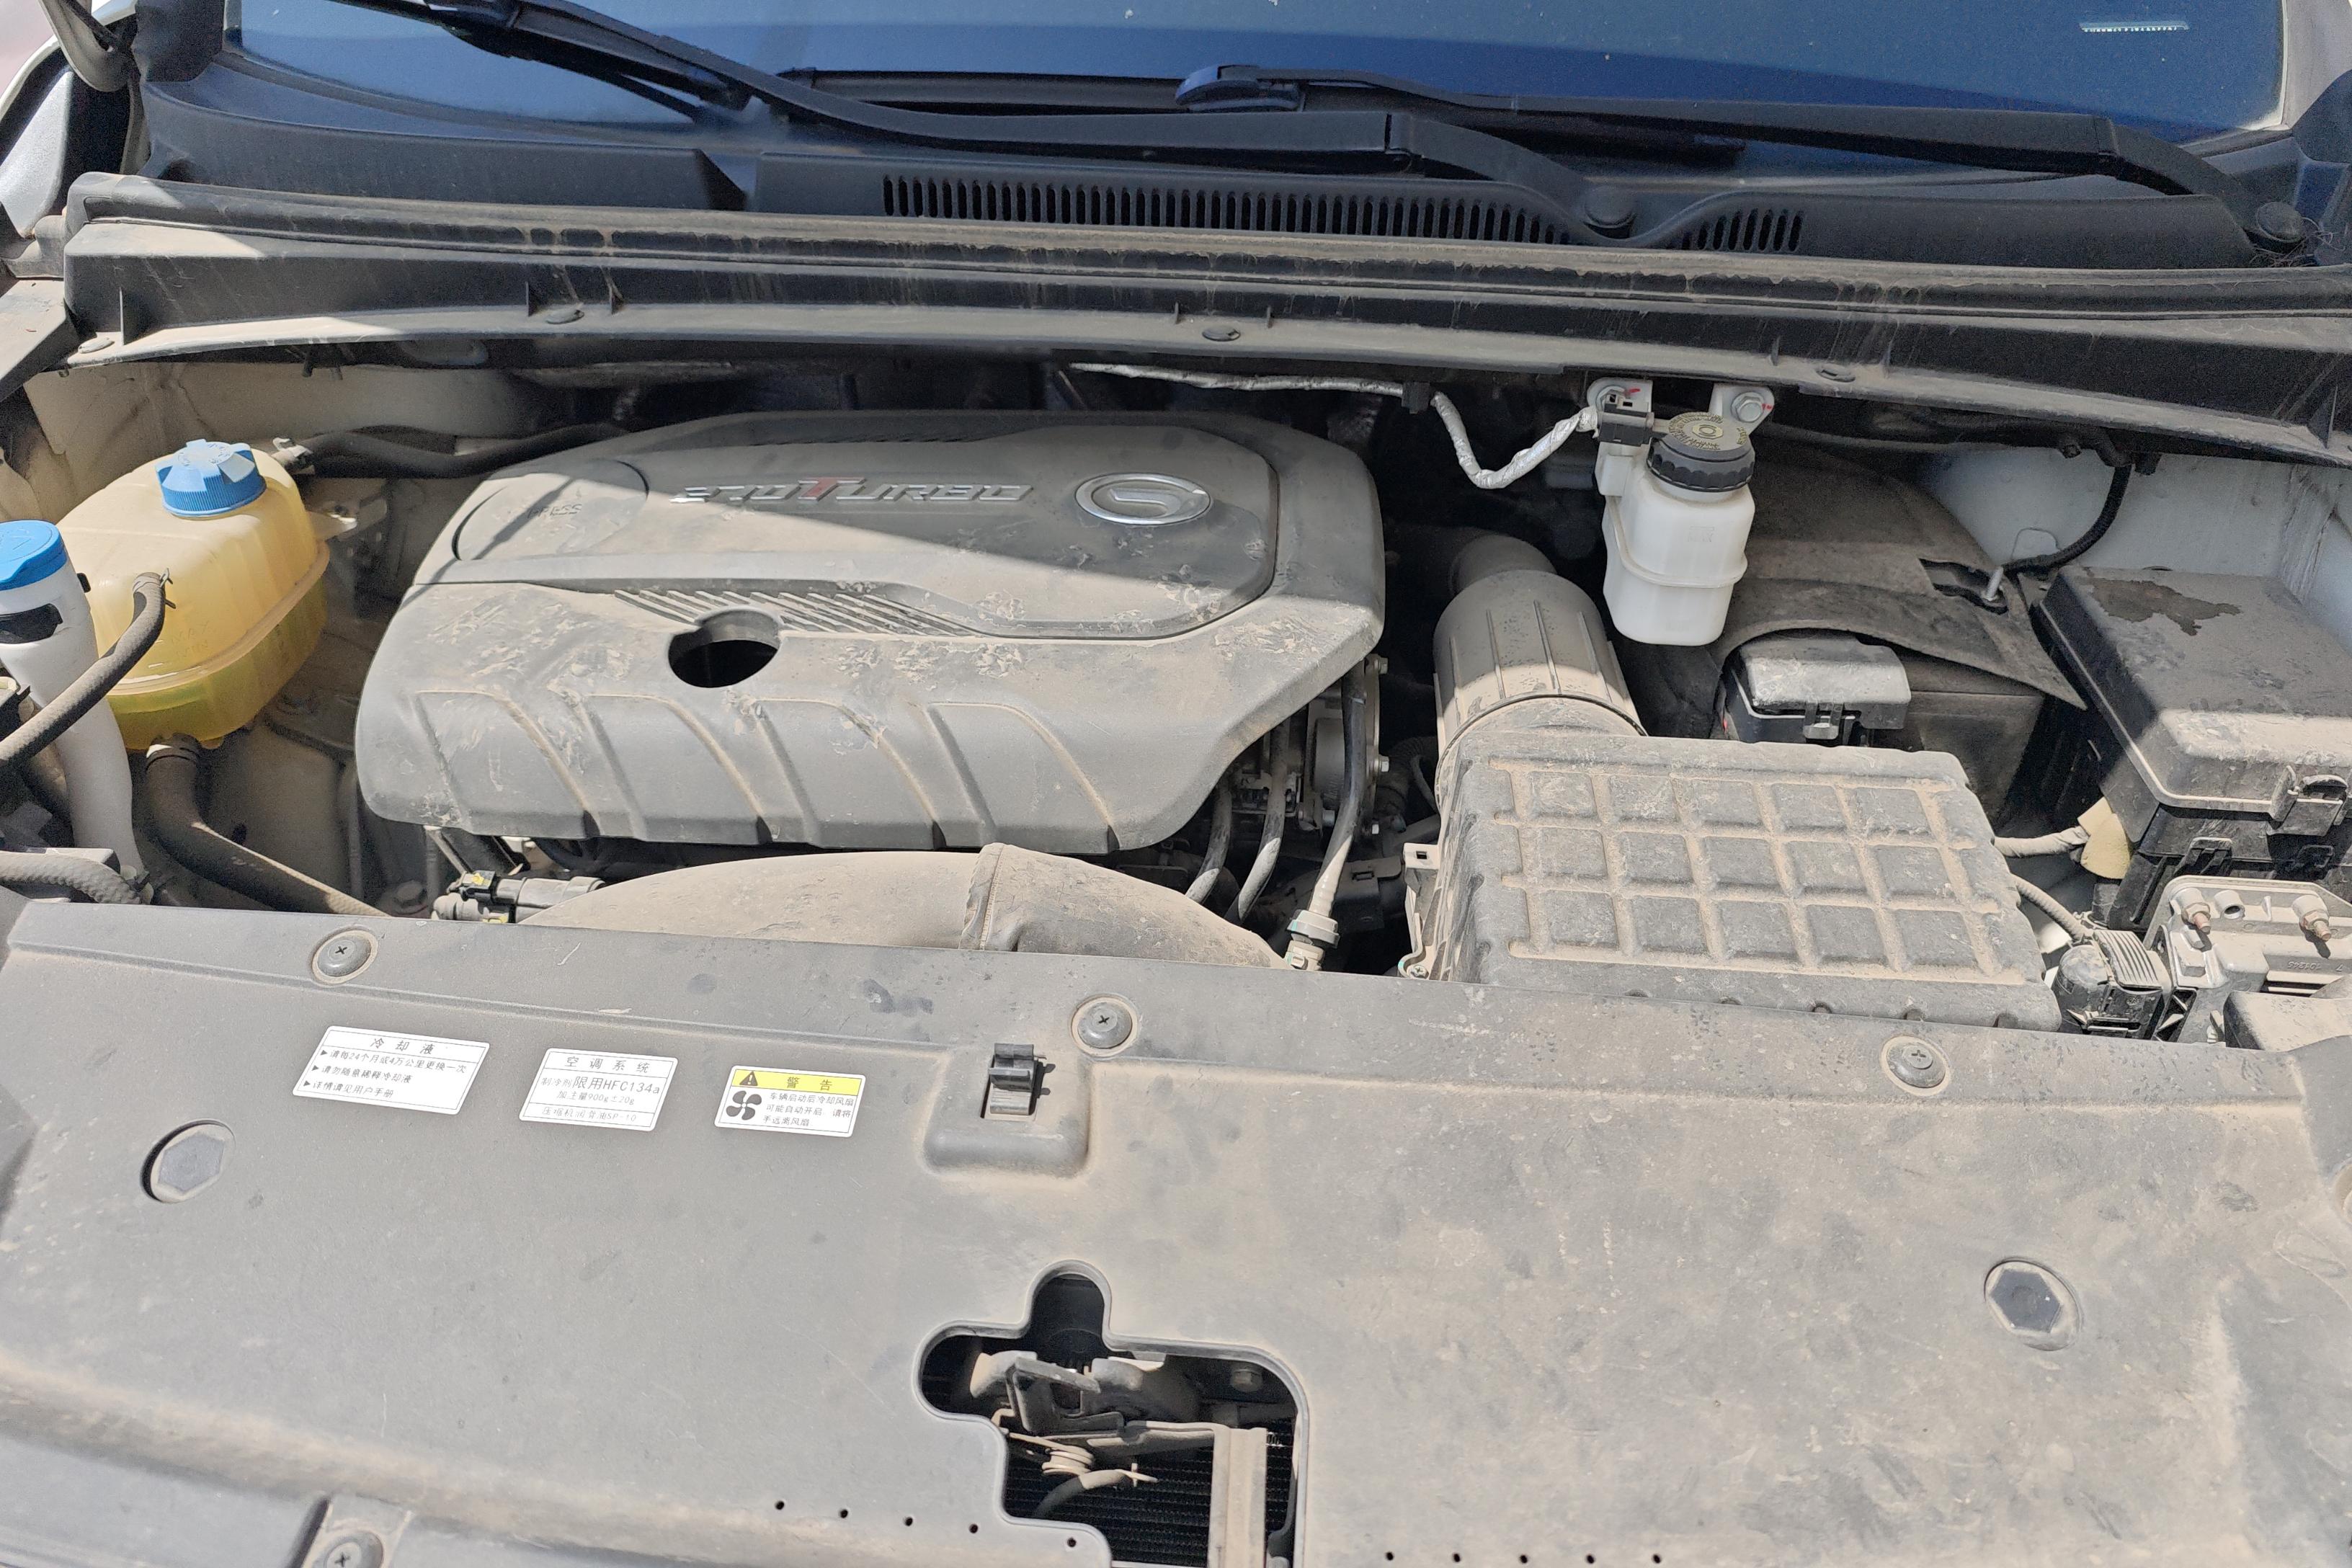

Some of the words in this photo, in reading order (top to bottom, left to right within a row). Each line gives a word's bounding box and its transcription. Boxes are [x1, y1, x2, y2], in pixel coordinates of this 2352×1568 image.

[370, 1038, 436, 1055] 冷却液
[329, 1049, 467, 1074] 请每24个月或4万公里更换一次
[565, 1056, 650, 1073] 空调系统
[321, 1065, 413, 1084] 请勿随意稀释冷却液
[312, 1081, 395, 1099] 详情请见用户手册
[786, 1077, 833, 1092] 警告
[769, 1092, 854, 1106] 车辆启动后冷却风扇
[763, 1115, 810, 1127] 手远离风扇
